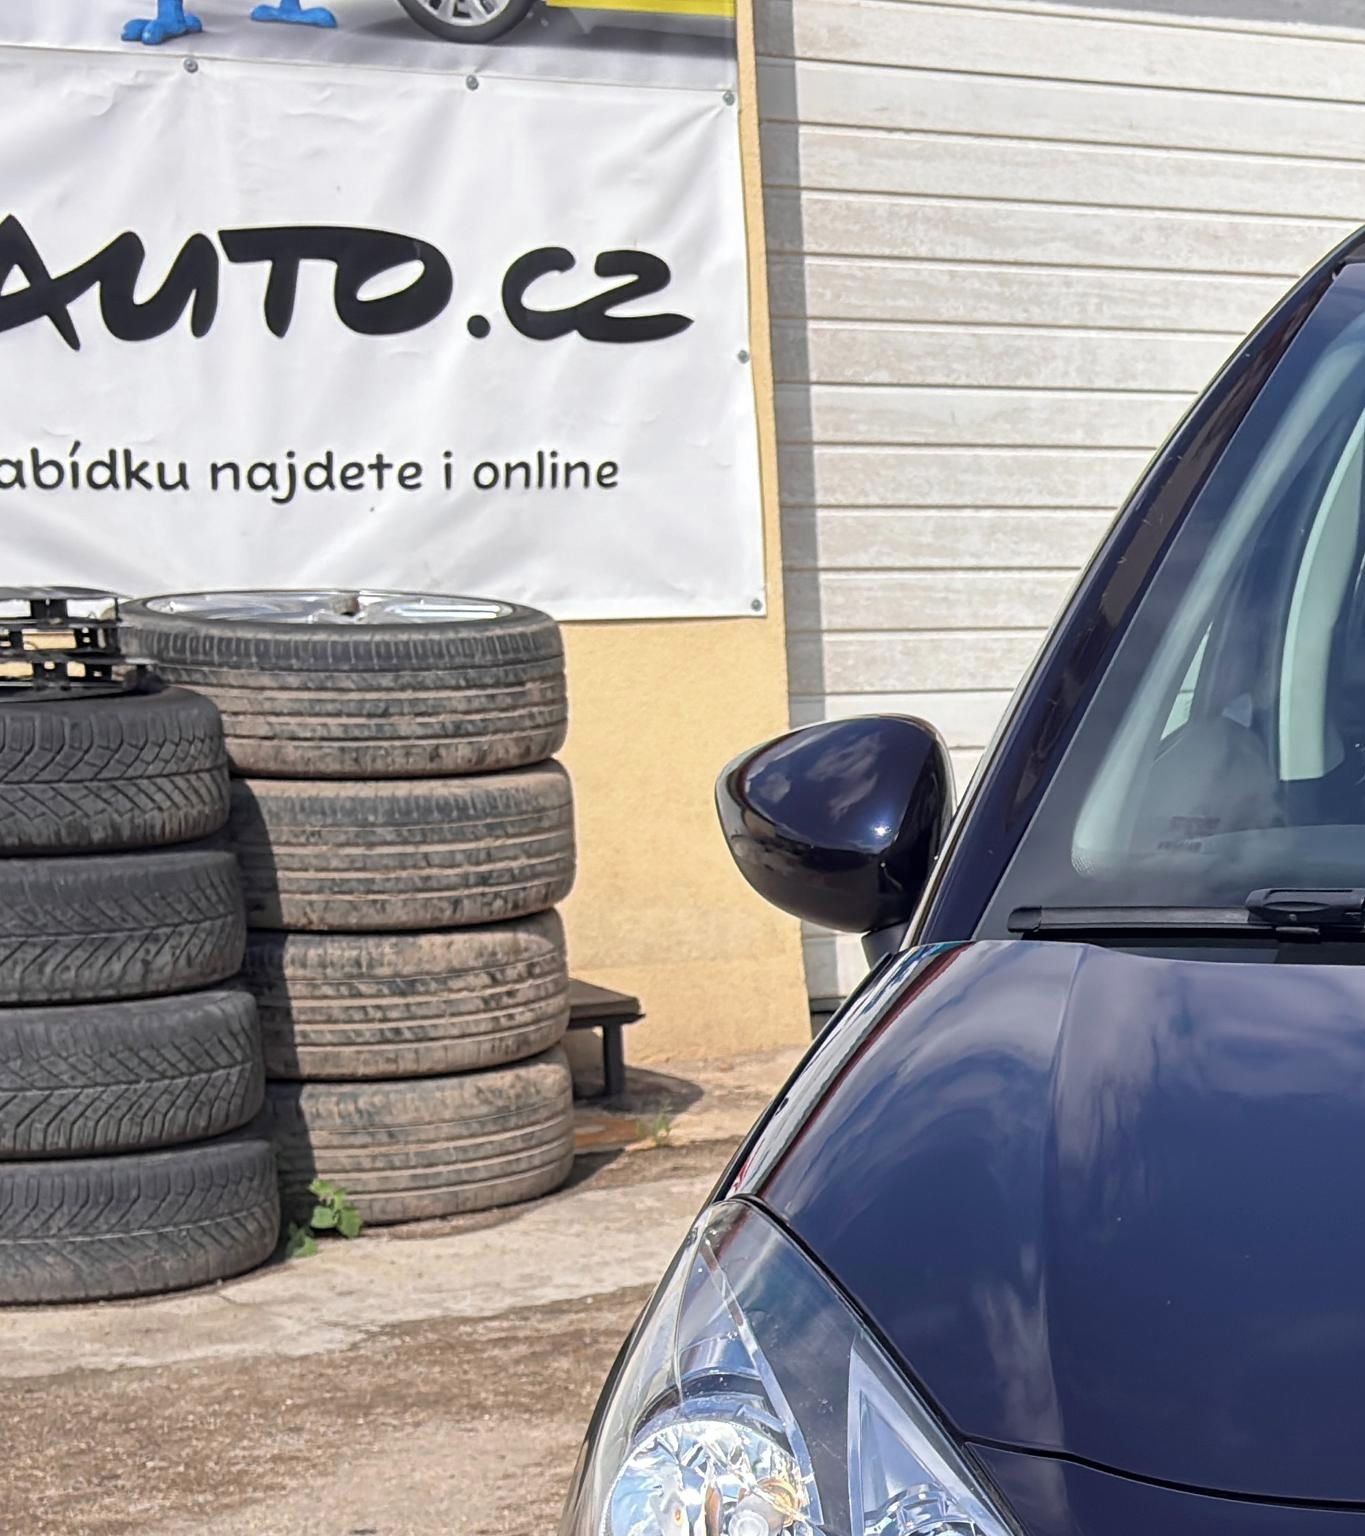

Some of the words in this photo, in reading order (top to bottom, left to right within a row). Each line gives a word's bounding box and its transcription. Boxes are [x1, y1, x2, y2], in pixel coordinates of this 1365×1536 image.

[210, 449, 422, 504] najdete
[443, 449, 453, 490] i
[473, 450, 619, 490] online
